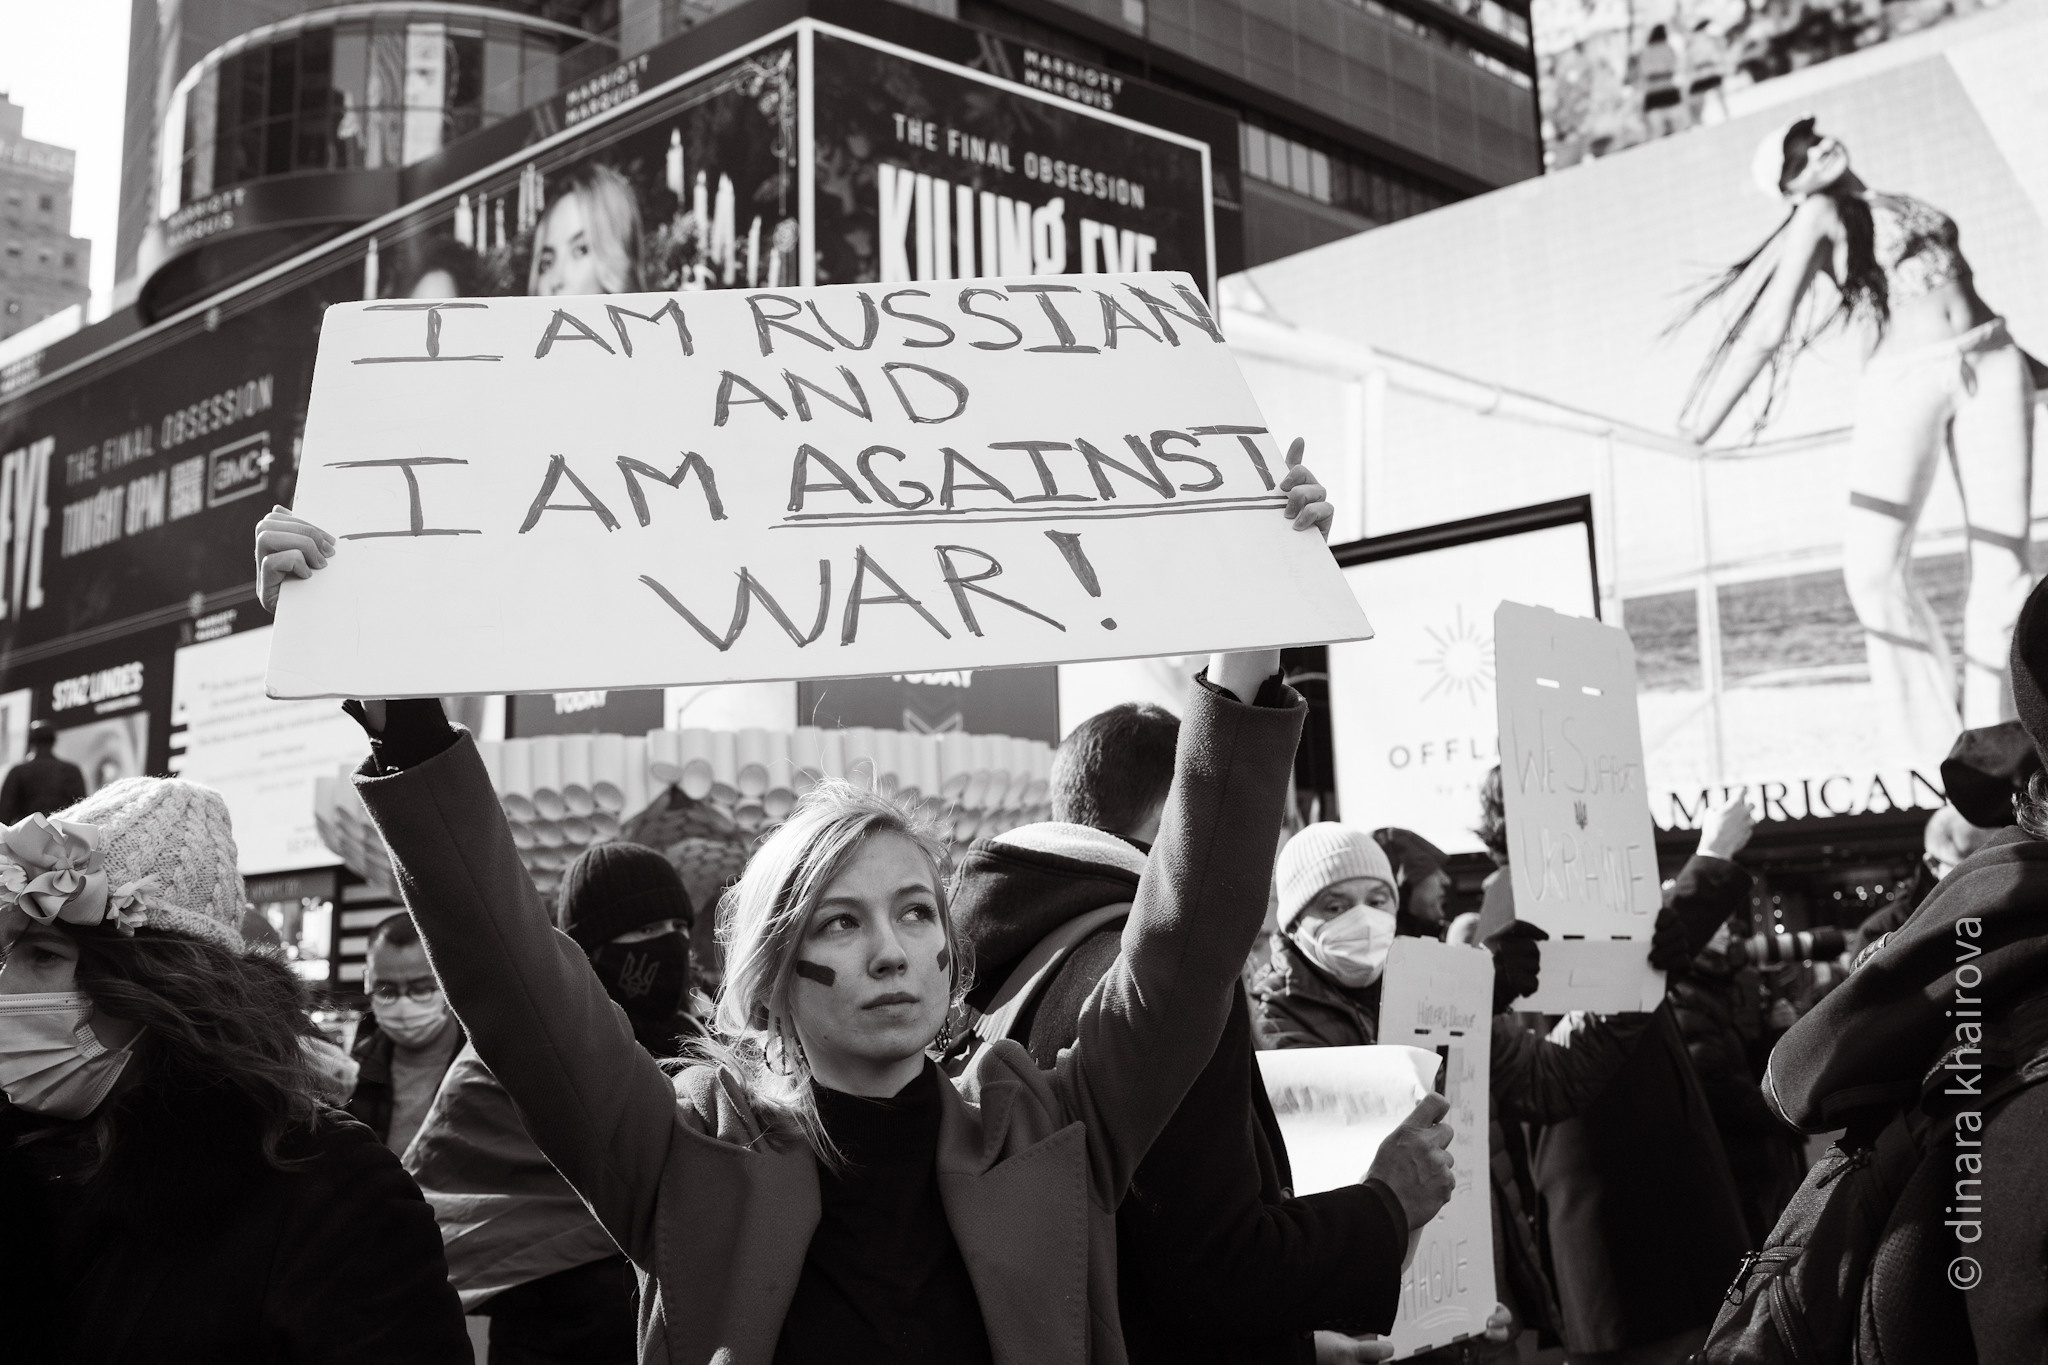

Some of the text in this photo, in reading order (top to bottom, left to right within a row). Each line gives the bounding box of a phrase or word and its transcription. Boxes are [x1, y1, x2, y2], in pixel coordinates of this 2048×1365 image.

[1023, 49, 1123, 95] MARRIOTT
[1024, 67, 1114, 111] MARQUIS
[892, 112, 1145, 210] THE FINAL OBSESSION
[350, 279, 1226, 364] I AM RUSSIAN
[160, 373, 275, 449] OBSESSION
[713, 362, 970, 427] AND
[322, 426, 1277, 540] I AM AGAINST
[638, 529, 1120, 652] WAR!
